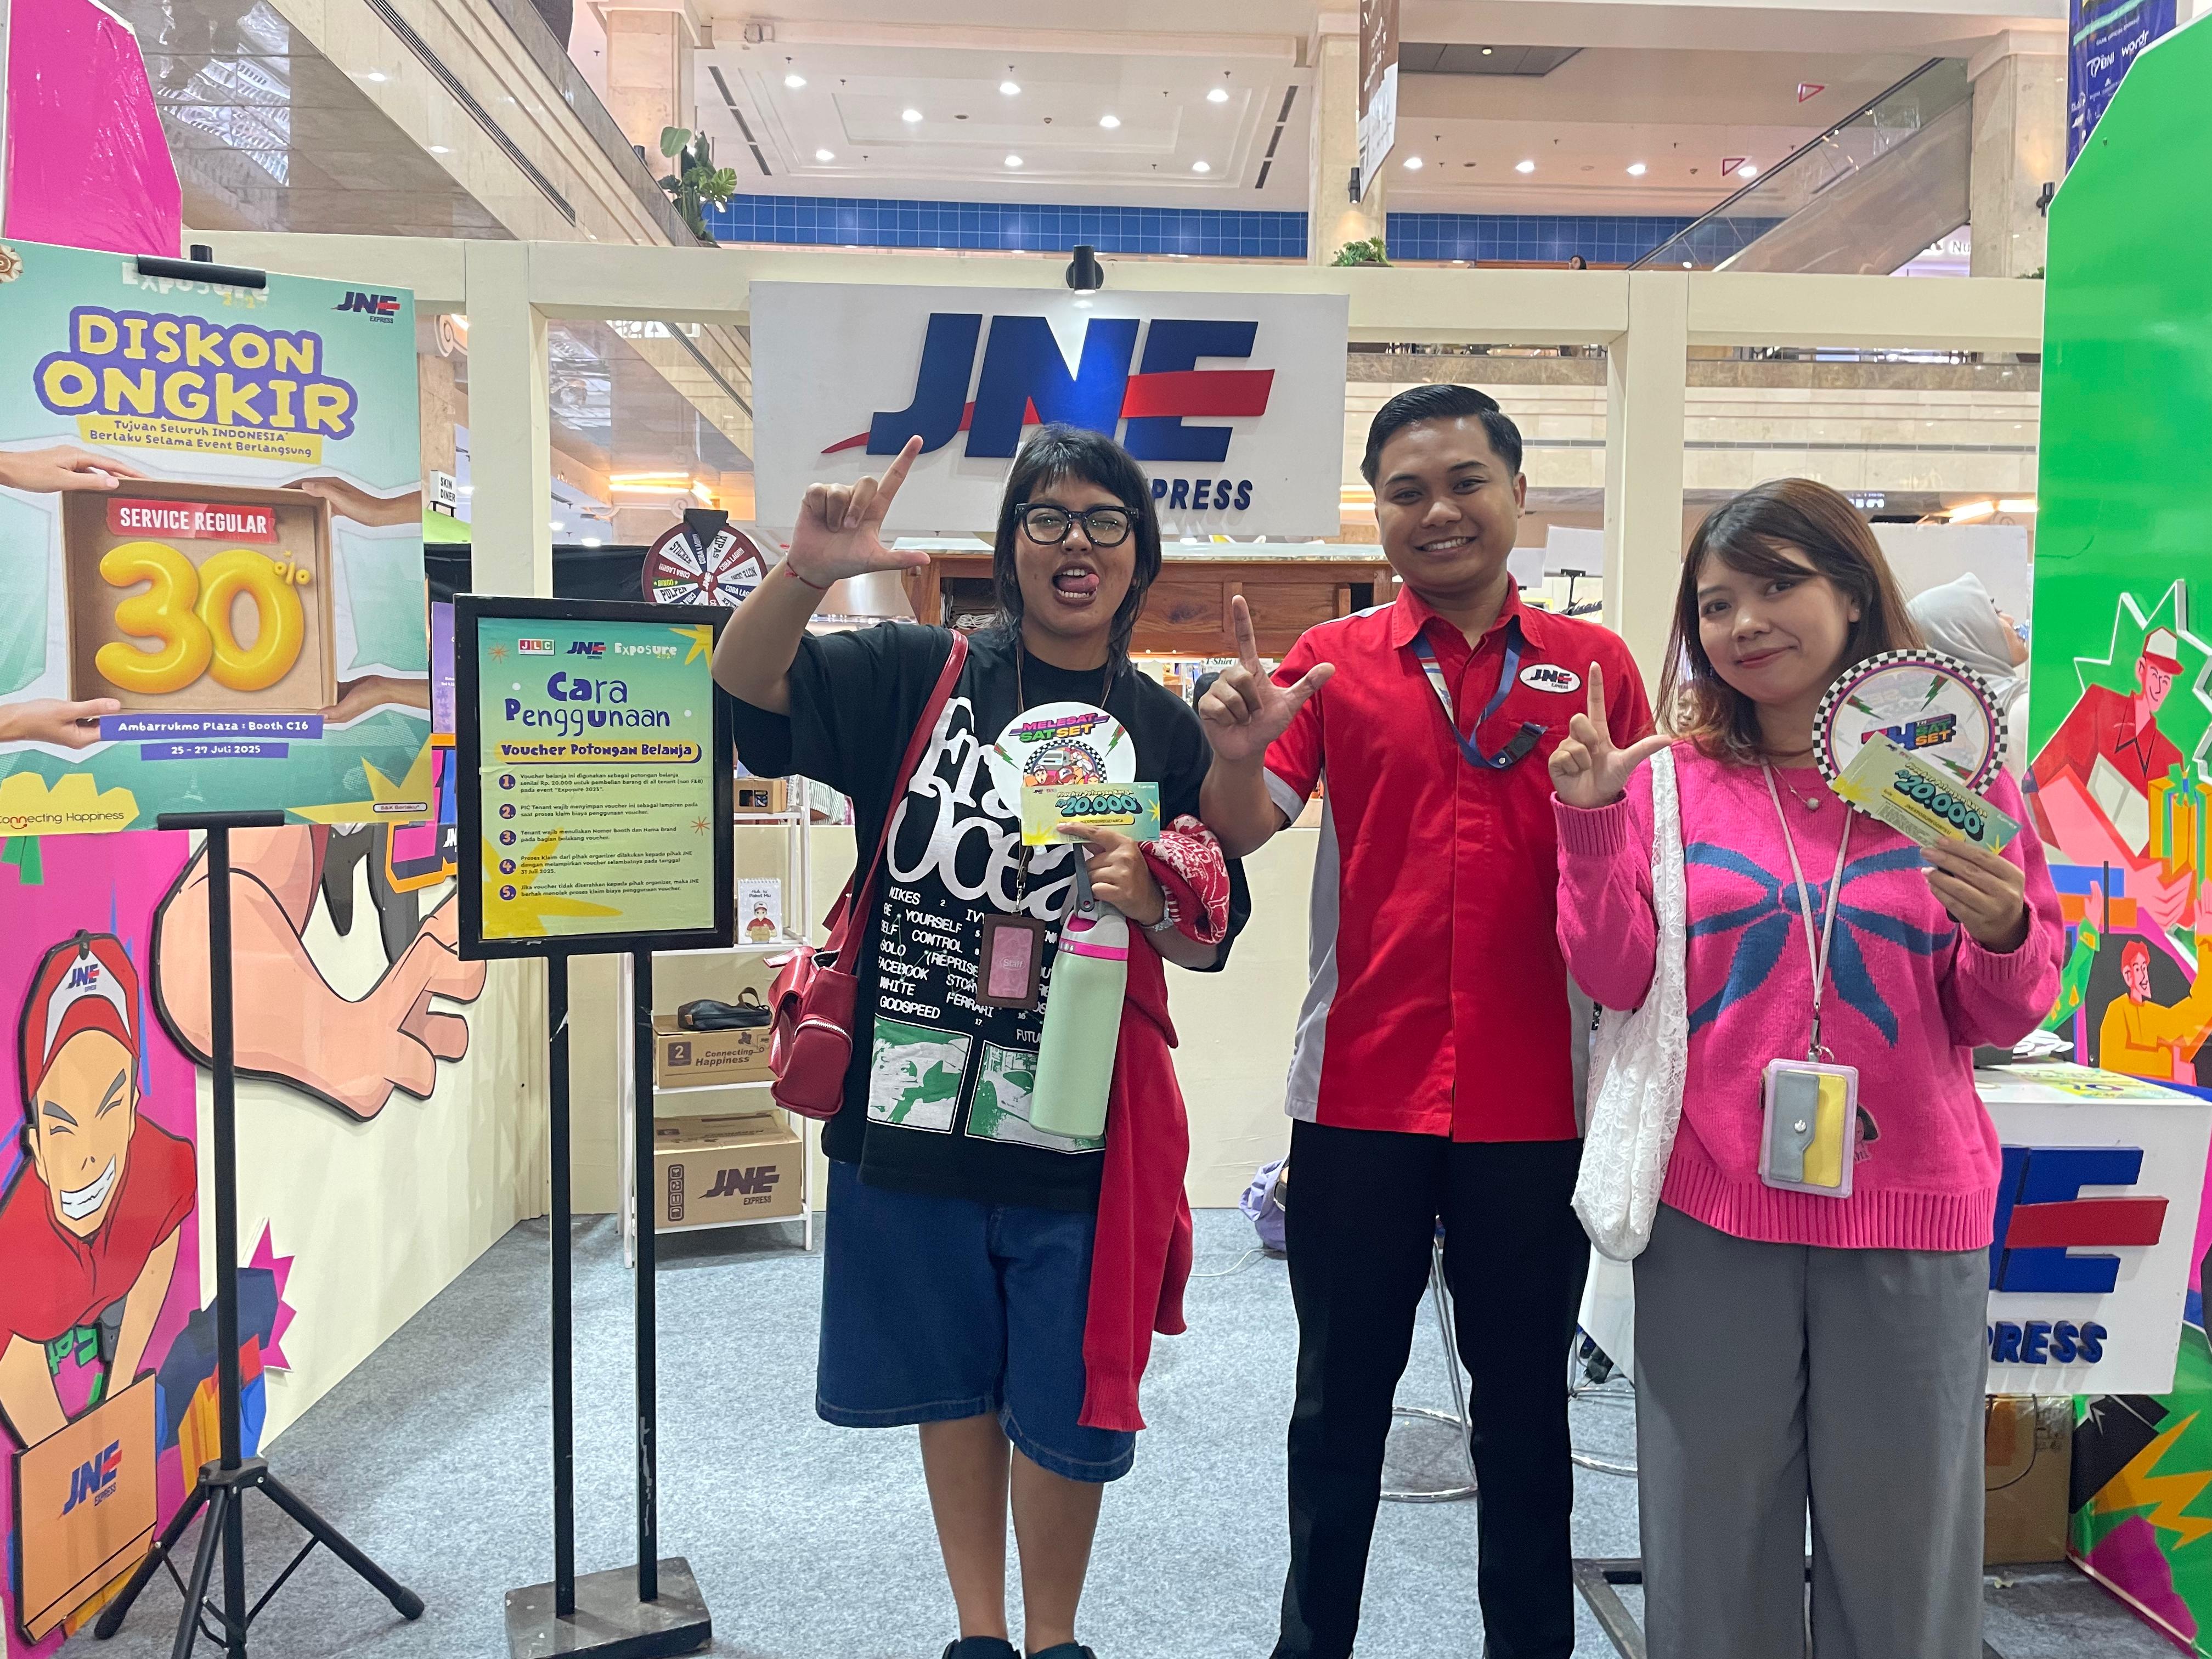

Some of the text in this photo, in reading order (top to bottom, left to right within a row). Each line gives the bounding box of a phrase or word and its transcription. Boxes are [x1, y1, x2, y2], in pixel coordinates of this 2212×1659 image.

[332, 291, 400, 315] JNE
[79, 314, 314, 375] DISKON
[44, 359, 350, 433] ONGKIR
[866, 313, 1275, 462] JNE
[114, 420, 157, 433] Tujuan
[161, 424, 209, 436] Seluruh
[89, 430, 312, 458] Berlaku Selama Event Berlangsung
[441, 477, 453, 490] SKIN
[441, 489, 455, 503] DINER
[1152, 479, 1252, 510] PRESS
[120, 507, 267, 534] SERVICE REGULAR
[714, 534, 728, 559] KIPAS
[719, 559, 732, 571] COBA
[676, 570, 690, 579] COBA
[725, 585, 739, 595] COBA
[520, 640, 554, 651] JLC
[566, 641, 606, 654] JNE
[614, 642, 677, 656] Exposure
[1530, 669, 1572, 684] JNE
[546, 672, 628, 704] Cara
[118, 721, 308, 731] Ambarrukmo Plaza Booth C16
[505, 698, 670, 737] Penggunaan
[1022, 713, 1097, 730] MELESAT
[1019, 724, 1093, 743] SAT SET
[1915, 730, 1951, 746] SET
[171, 745, 261, 755] 25 27 Juli 2025
[501, 742, 692, 758] Voucher Potongan Belanja
[66, 812, 124, 823] Happiness
[889, 886, 921, 905] NIKES
[883, 902, 893, 916] BE
[905, 909, 963, 933] YOURSELF
[881, 919, 963, 953] SELF CONTROL
[879, 939, 906, 956] SOLO
[1003, 958, 1023, 968] Staff
[66, 963, 100, 988] JNE
[879, 976, 916, 996] WHITE
[879, 995, 941, 1019] GODSPEED
[675, 1045, 753, 1059] 2 Connecting
[695, 1056, 750, 1067] Happiness
[706, 1165, 780, 1198] JNE
[743, 1195, 772, 1206] EXPRESS
[1988, 1319, 2108, 1364] RESS
[64, 1438, 123, 1516] JNE
